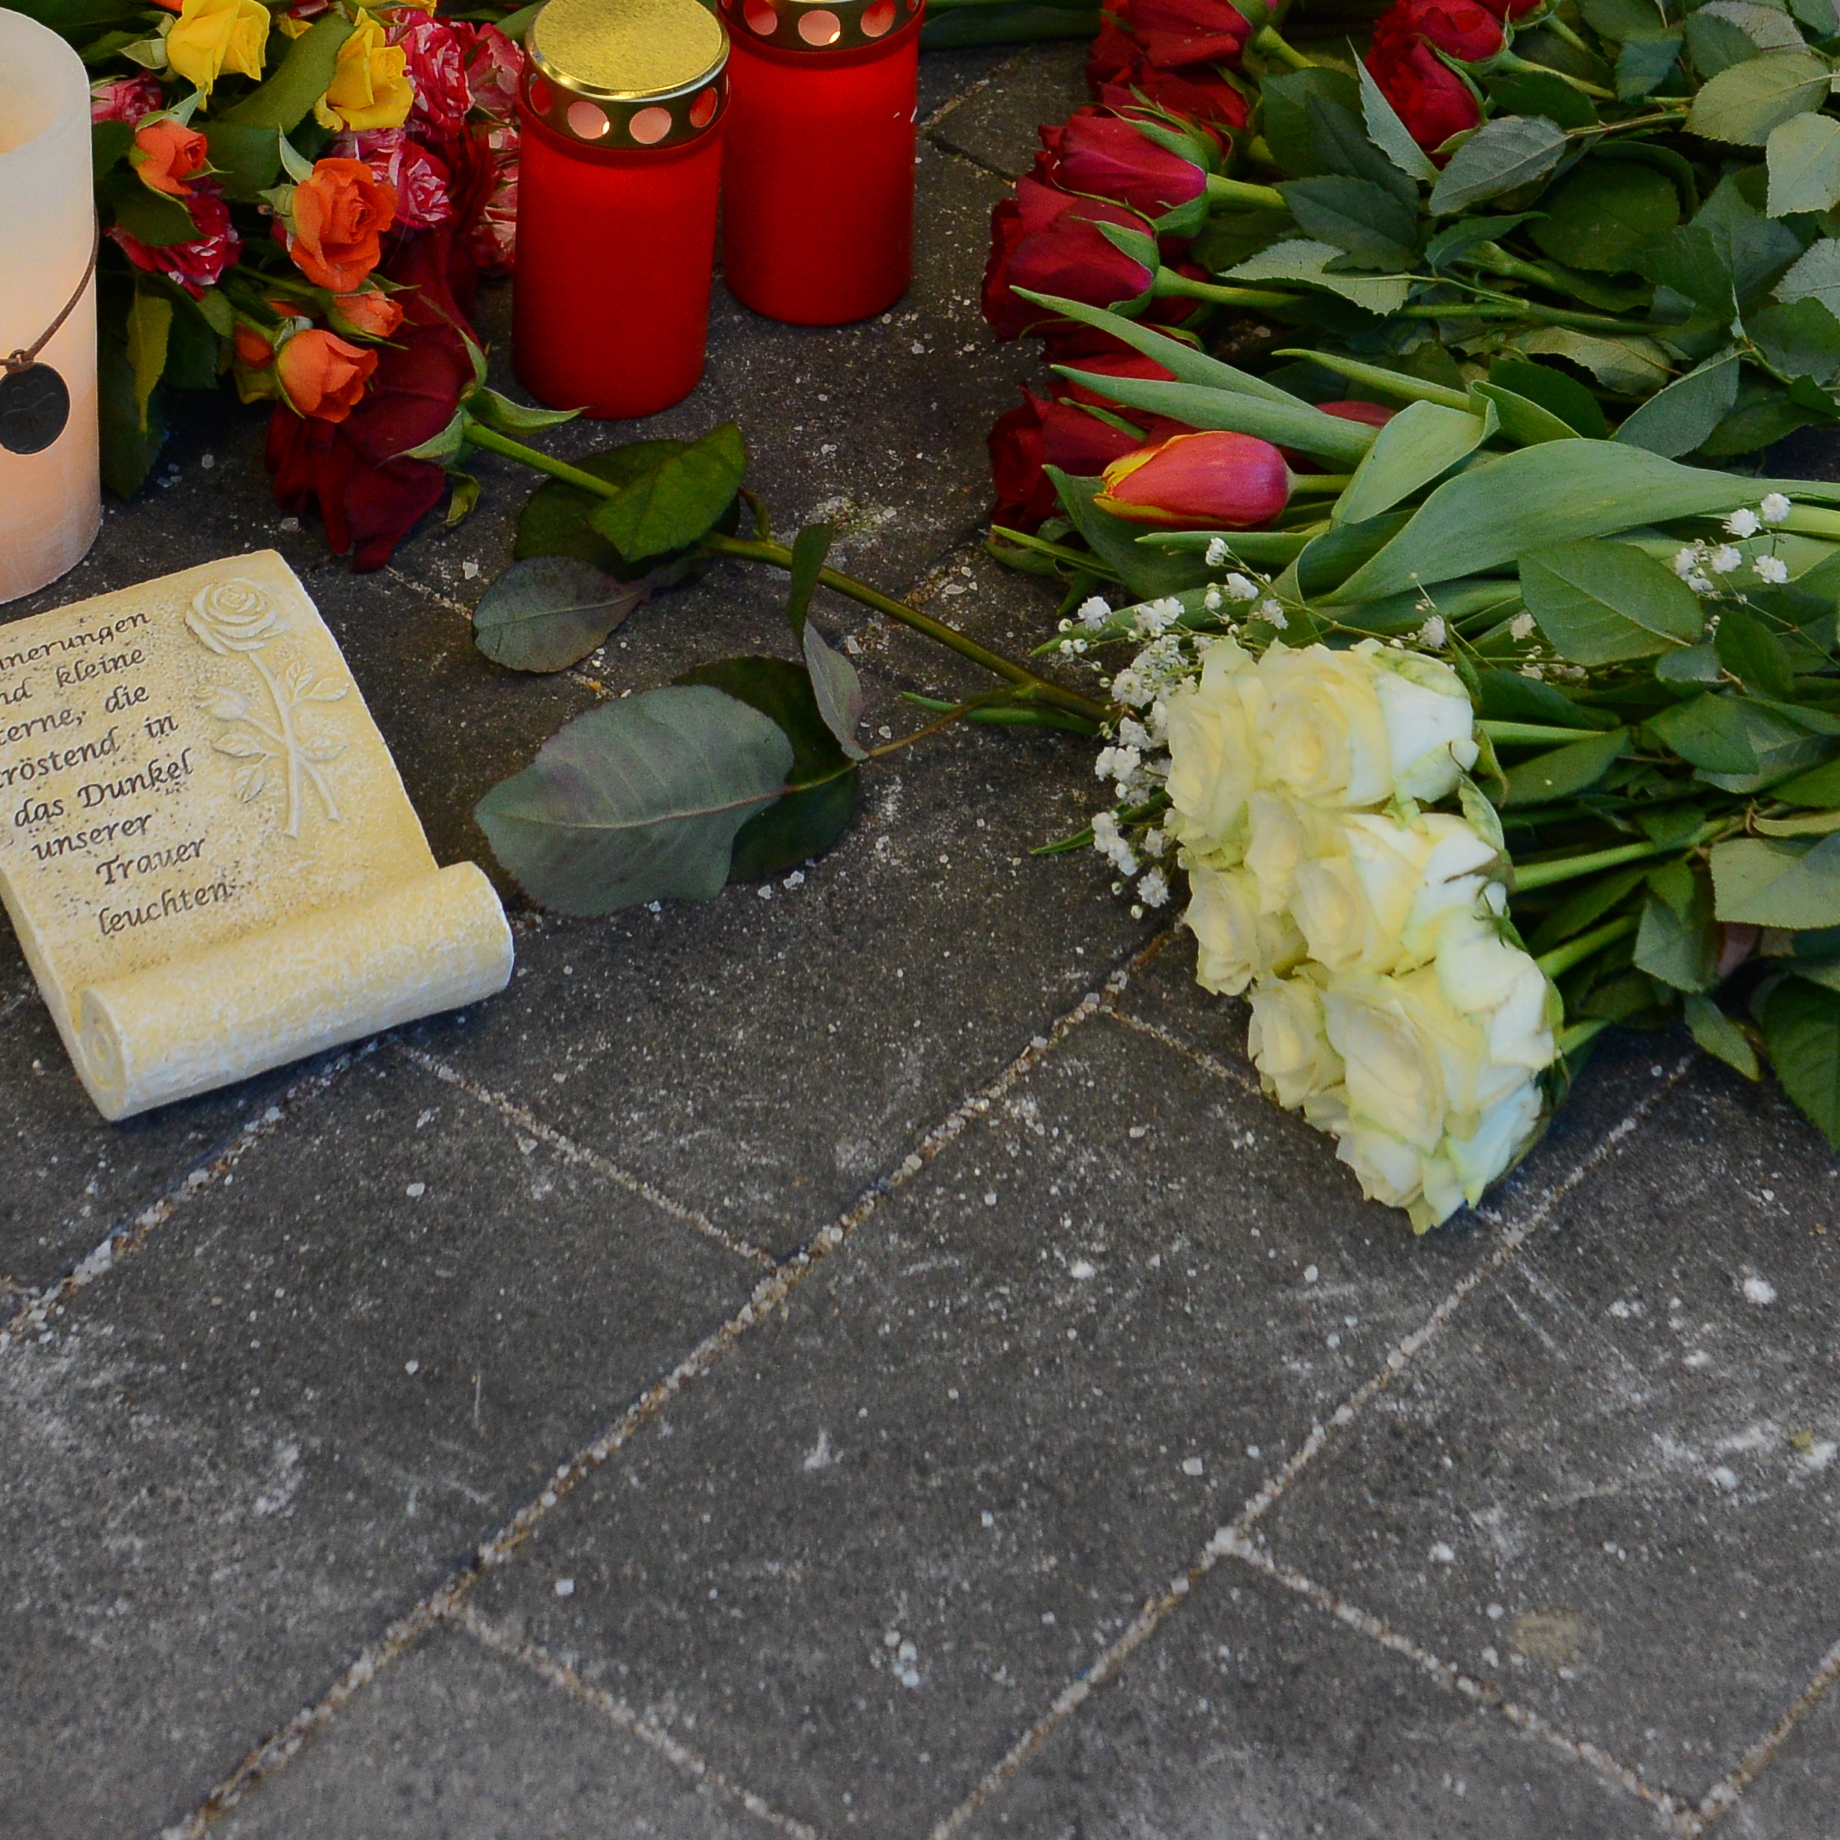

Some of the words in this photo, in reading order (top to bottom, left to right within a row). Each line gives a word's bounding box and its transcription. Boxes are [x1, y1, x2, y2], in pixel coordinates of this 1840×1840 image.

[56, 647, 146, 688] kleine
[105, 685, 150, 714] die
[144, 714, 179, 739] in
[14, 798, 64, 827] das
[77, 748, 194, 809] Dunkel
[31, 813, 153, 861] unserer
[96, 835, 205, 885] Trauer
